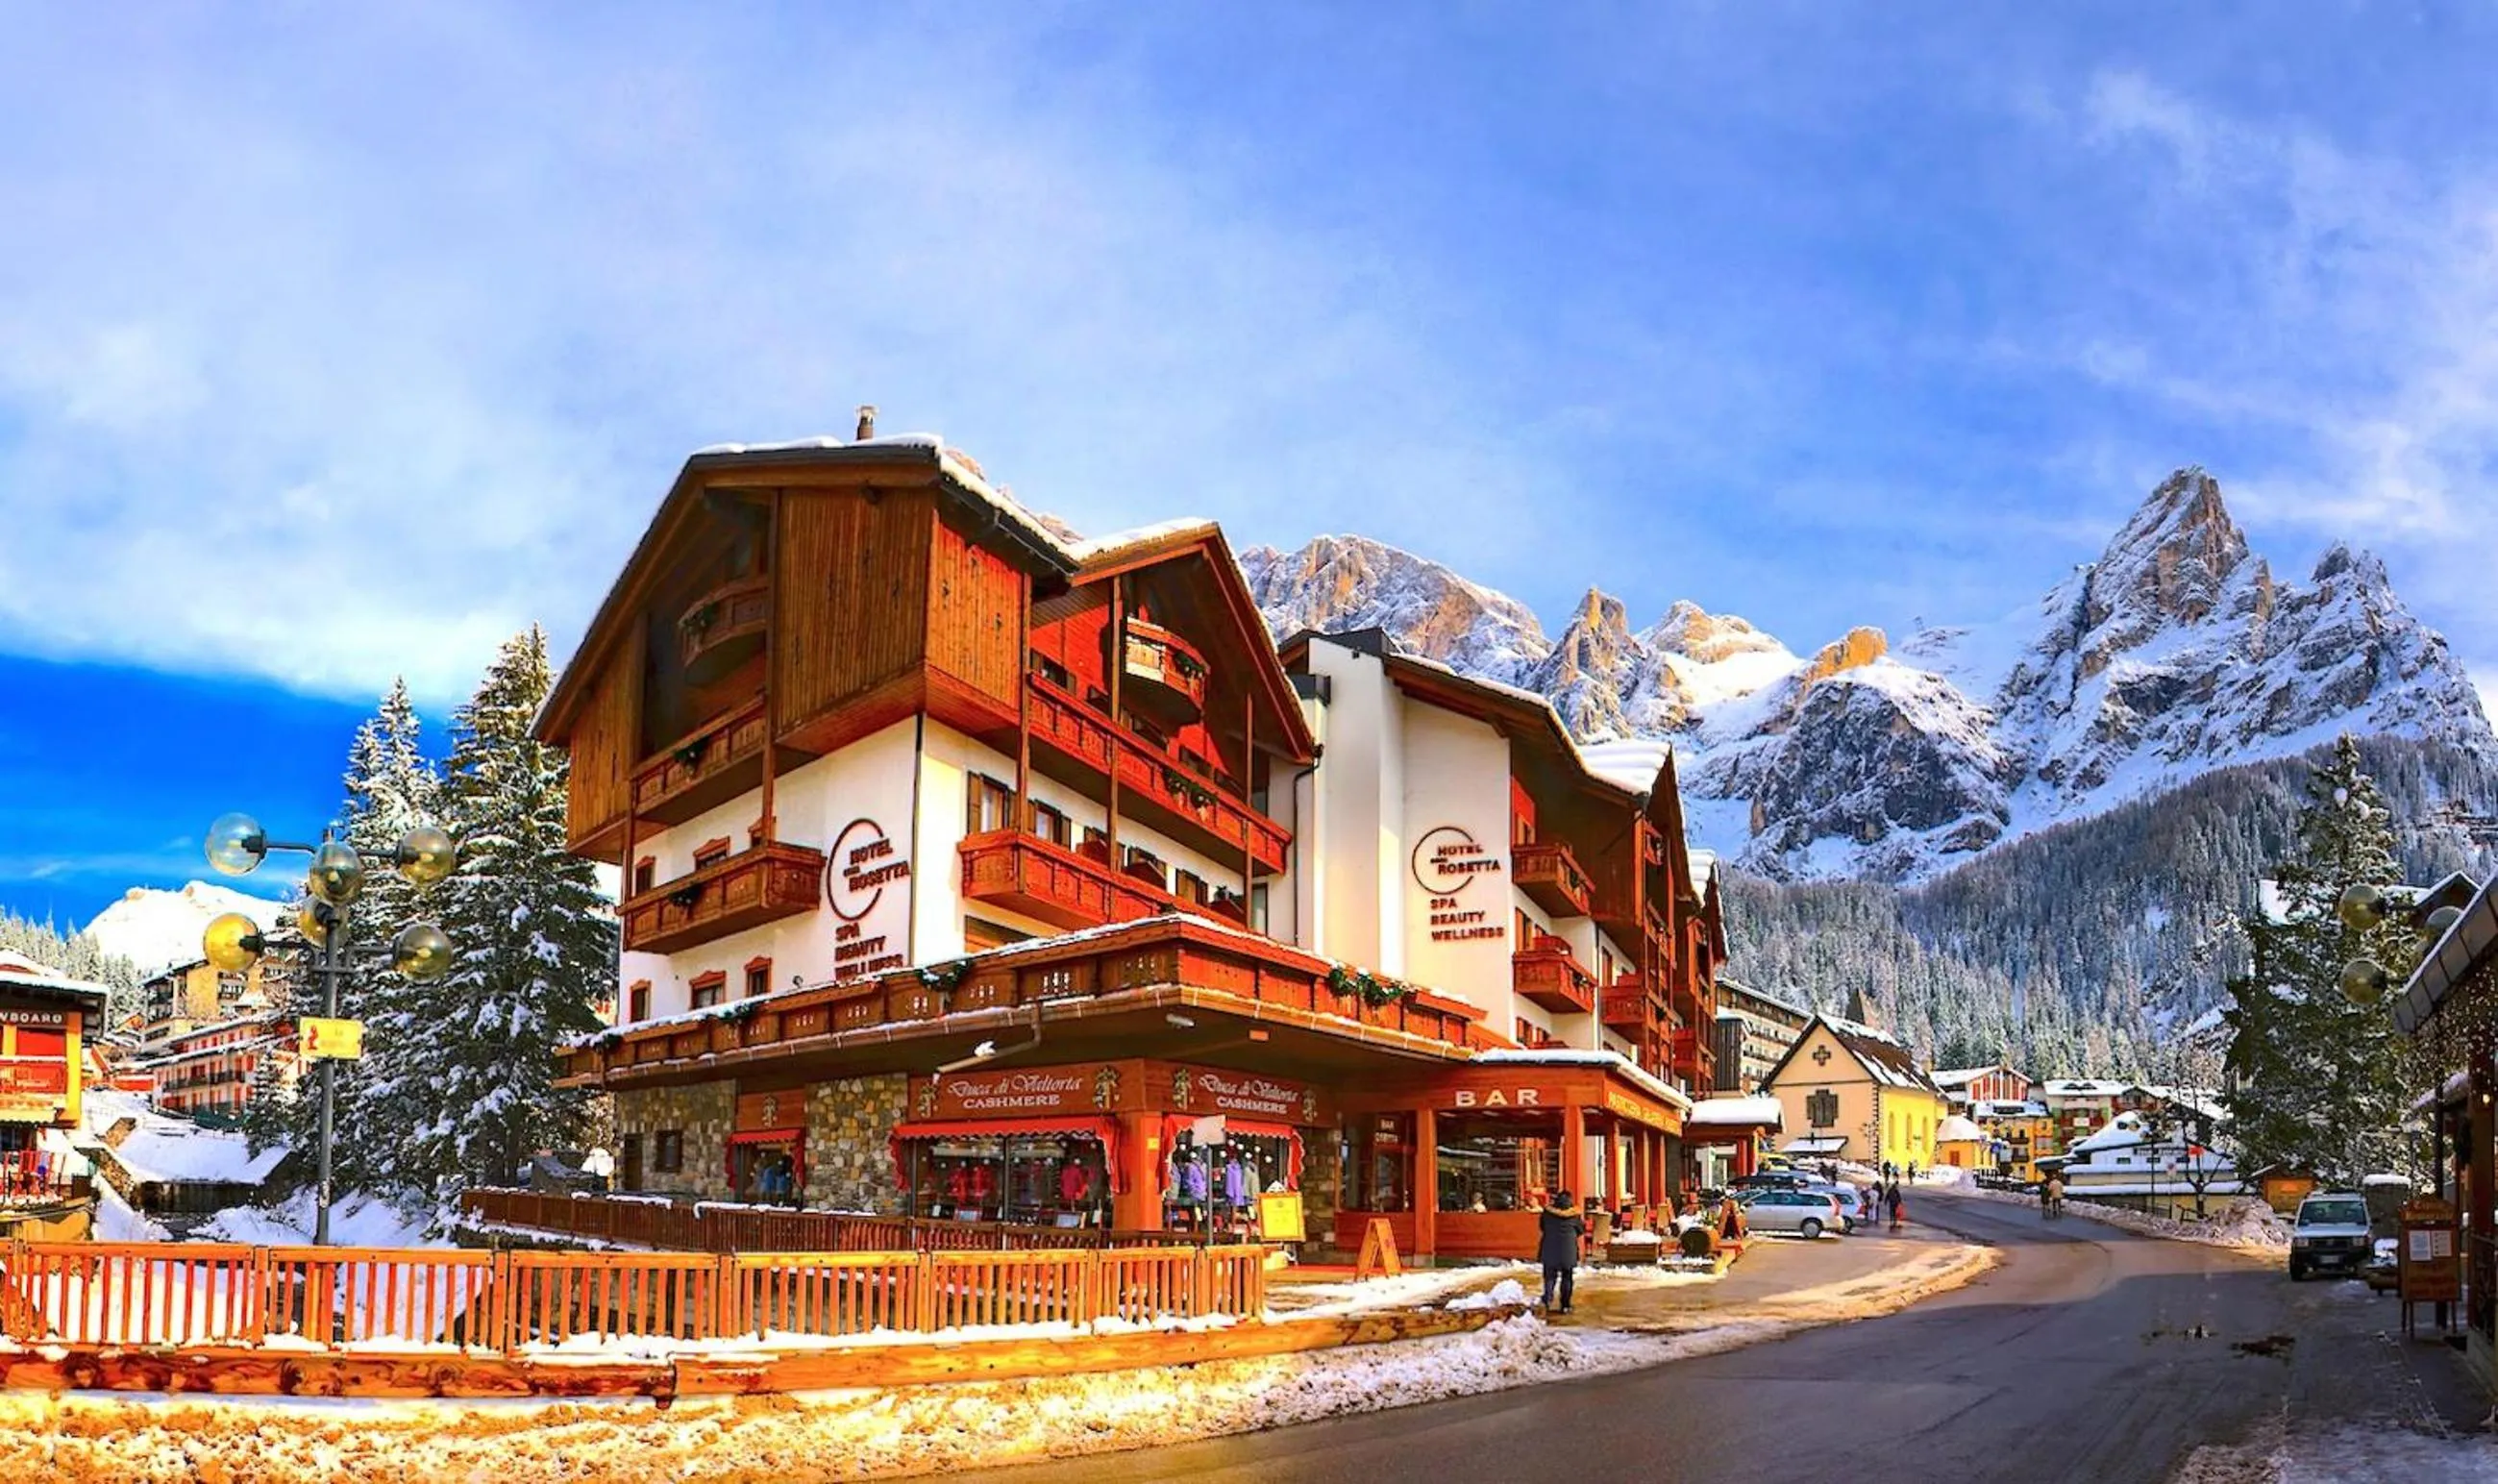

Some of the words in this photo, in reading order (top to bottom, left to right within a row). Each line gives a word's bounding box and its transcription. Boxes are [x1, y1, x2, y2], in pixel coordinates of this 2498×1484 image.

[850, 838, 893, 865] HOTEL
[1437, 845, 1483, 856] HOTEL
[849, 860, 910, 892] ROSETTA
[1437, 859, 1500, 876] ROSETTA
[1429, 897, 1457, 910] SPA
[1430, 910, 1485, 926] BEAUTY
[835, 922, 860, 942] SPA
[1431, 927, 1504, 941] WELLNESS
[834, 935, 886, 962] BEAUTY
[963, 1094, 1060, 1109] CASHMERE
[1216, 1096, 1288, 1115] CASHMERE
[1455, 1088, 1540, 1107] BAR
